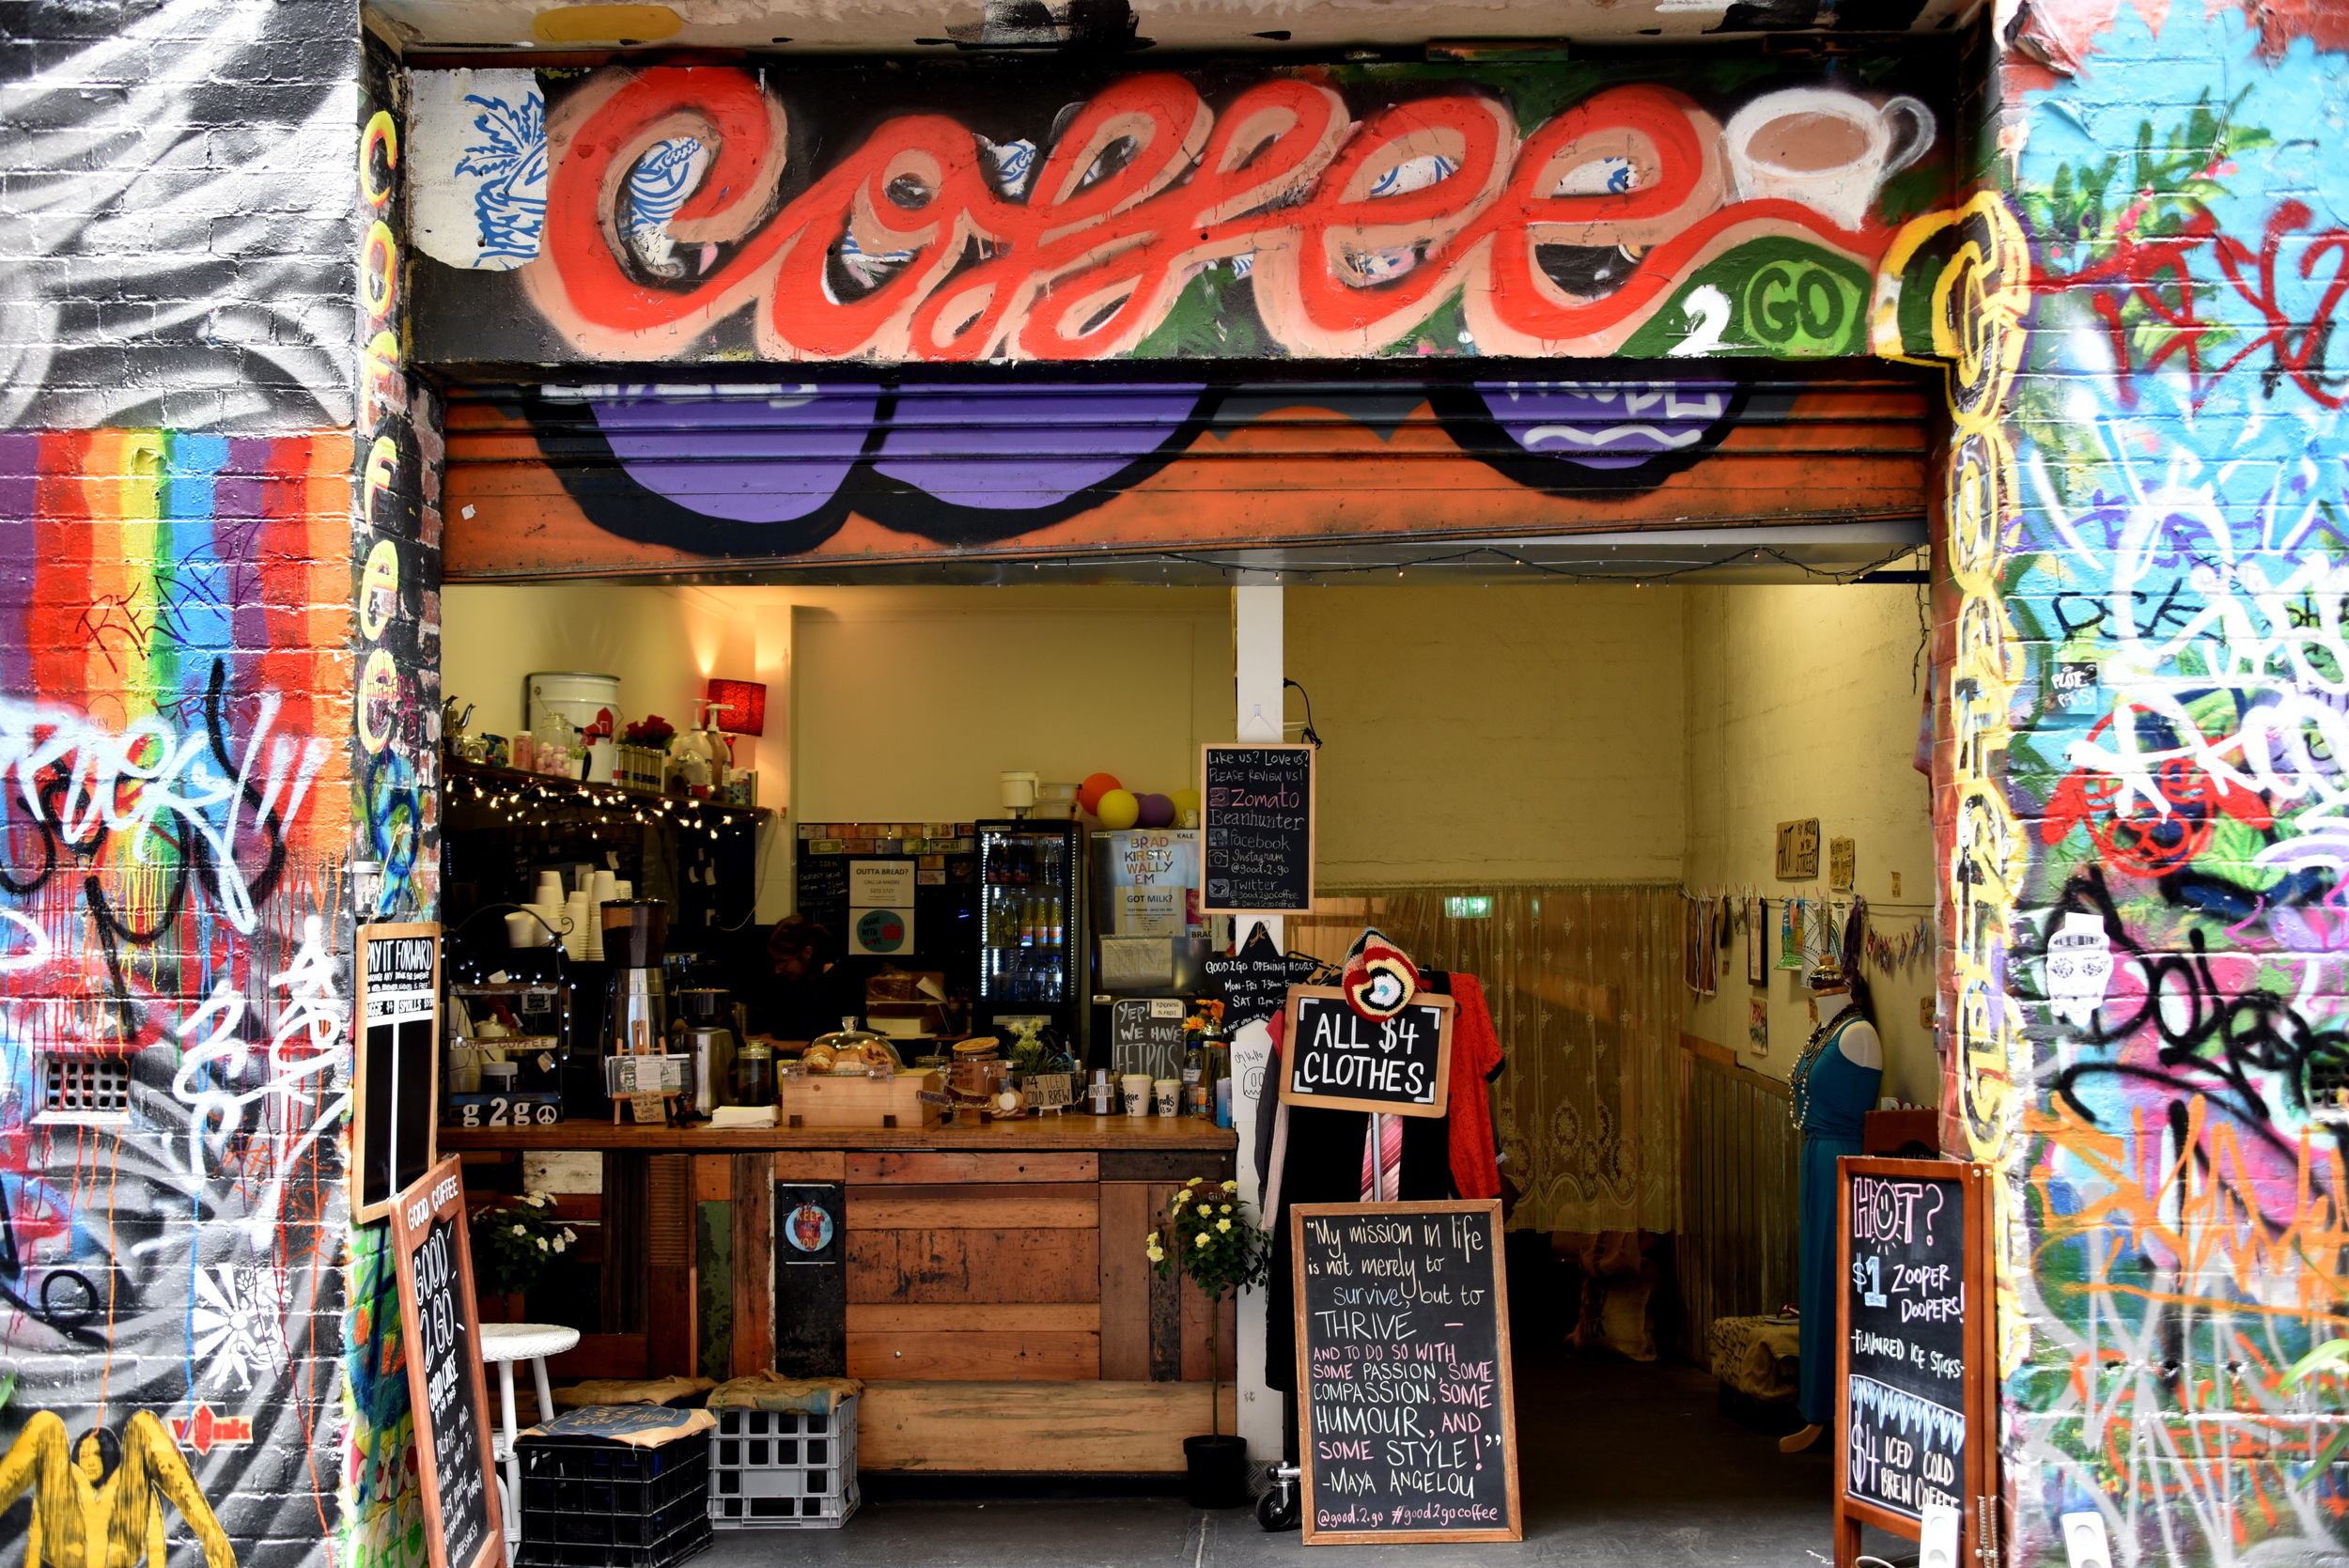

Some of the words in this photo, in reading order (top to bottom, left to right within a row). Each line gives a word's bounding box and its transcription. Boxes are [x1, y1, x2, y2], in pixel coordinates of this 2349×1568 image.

[1671, 284, 1748, 357] 2
[1748, 269, 1846, 344] GO
[1208, 751, 1235, 765] Like
[1239, 751, 1259, 764] us?
[1265, 751, 1291, 766] Love
[1293, 751, 1309, 768] us?
[1208, 768, 1244, 783] PLEASE
[1249, 769, 1283, 783] REVIEW
[1286, 769, 1303, 784] US!
[1231, 783, 1299, 809] Zomato
[1209, 809, 1305, 831] Beanhunter
[1130, 836, 1169, 848] BRAD
[1777, 825, 1795, 875] ART
[1125, 849, 1172, 862] KIRSTY
[1127, 862, 1173, 874] WALLY
[1232, 849, 1284, 865] Instagram
[1135, 874, 1155, 884] EM
[1231, 863, 1289, 876] @good.2.go
[1232, 878, 1278, 891] Twitter
[1147, 894, 1173, 903] MILK?
[383, 940, 394, 971] IT
[396, 939, 433, 970] FORWARD
[1252, 959, 1285, 976] OPENING
[1289, 962, 1315, 971] HOURS
[1118, 1001, 1150, 1023] YEP!
[1233, 995, 1251, 1008] SAT
[1121, 1023, 1144, 1040] WE
[1151, 1026, 1183, 1043] HAVE
[1228, 1018, 1240, 1031] NOT
[1314, 1013, 1369, 1048] ALL
[1379, 1018, 1419, 1054] $4
[454, 1039, 485, 1049] LOVE
[498, 1038, 549, 1048] COFFEE
[1046, 1075, 1066, 1089] ICED
[1303, 1051, 1424, 1094] CLOTHES
[1026, 1090, 1044, 1106] COLD
[1049, 1088, 1070, 1105] BREW
[1088, 1085, 1113, 1097] DONATIONS
[408, 1198, 429, 1231] GOOD
[431, 1174, 459, 1212] COFFEE
[1854, 1176, 1944, 1247] HOT?
[796, 1210, 822, 1221] KEEP
[797, 1237, 821, 1249] YOUR
[1349, 1217, 1413, 1245] mission
[1423, 1216, 1441, 1248] in
[1452, 1215, 1484, 1263] life
[413, 1229, 448, 1306] GOOD
[1308, 1257, 1320, 1275] is
[1327, 1252, 1353, 1277] not
[1361, 1248, 1416, 1298] merely
[1426, 1254, 1444, 1272] to
[1852, 1251, 1888, 1309] $1
[1890, 1264, 1952, 1297] ZOOPER
[1419, 1280, 1453, 1306] but
[1460, 1284, 1485, 1306] to
[1901, 1281, 1966, 1324] DOOPERS!
[1315, 1310, 1417, 1341] THRIVE
[1314, 1346, 1341, 1361] AND
[1345, 1345, 1361, 1360] TO
[1365, 1344, 1383, 1360] DO
[1392, 1343, 1408, 1360] SO
[1416, 1343, 1456, 1363] WITH
[1910, 1342, 1925, 1370] ICE
[1314, 1364, 1354, 1380] SOME
[1362, 1362, 1443, 1385] PASSION,
[1448, 1360, 1495, 1383] SOME
[1314, 1381, 1437, 1405] COMPASSION,
[1439, 1382, 1493, 1408] SOME
[1315, 1405, 1436, 1439] HUMOUR,
[1441, 1411, 1482, 1435] AND
[454, 1442, 464, 1467] HELP
[1318, 1439, 1375, 1461] SOME
[1851, 1409, 1880, 1492] $4
[1885, 1436, 1914, 1469] ICED
[1922, 1451, 1955, 1486] COLD
[453, 1469, 468, 1505] PEOPLE
[1390, 1468, 1474, 1499] ANGELOU
[1880, 1467, 1912, 1506] BREW
[1317, 1503, 1384, 1528] @good.2.go
[1392, 1502, 1499, 1527] #good2gocoffee
